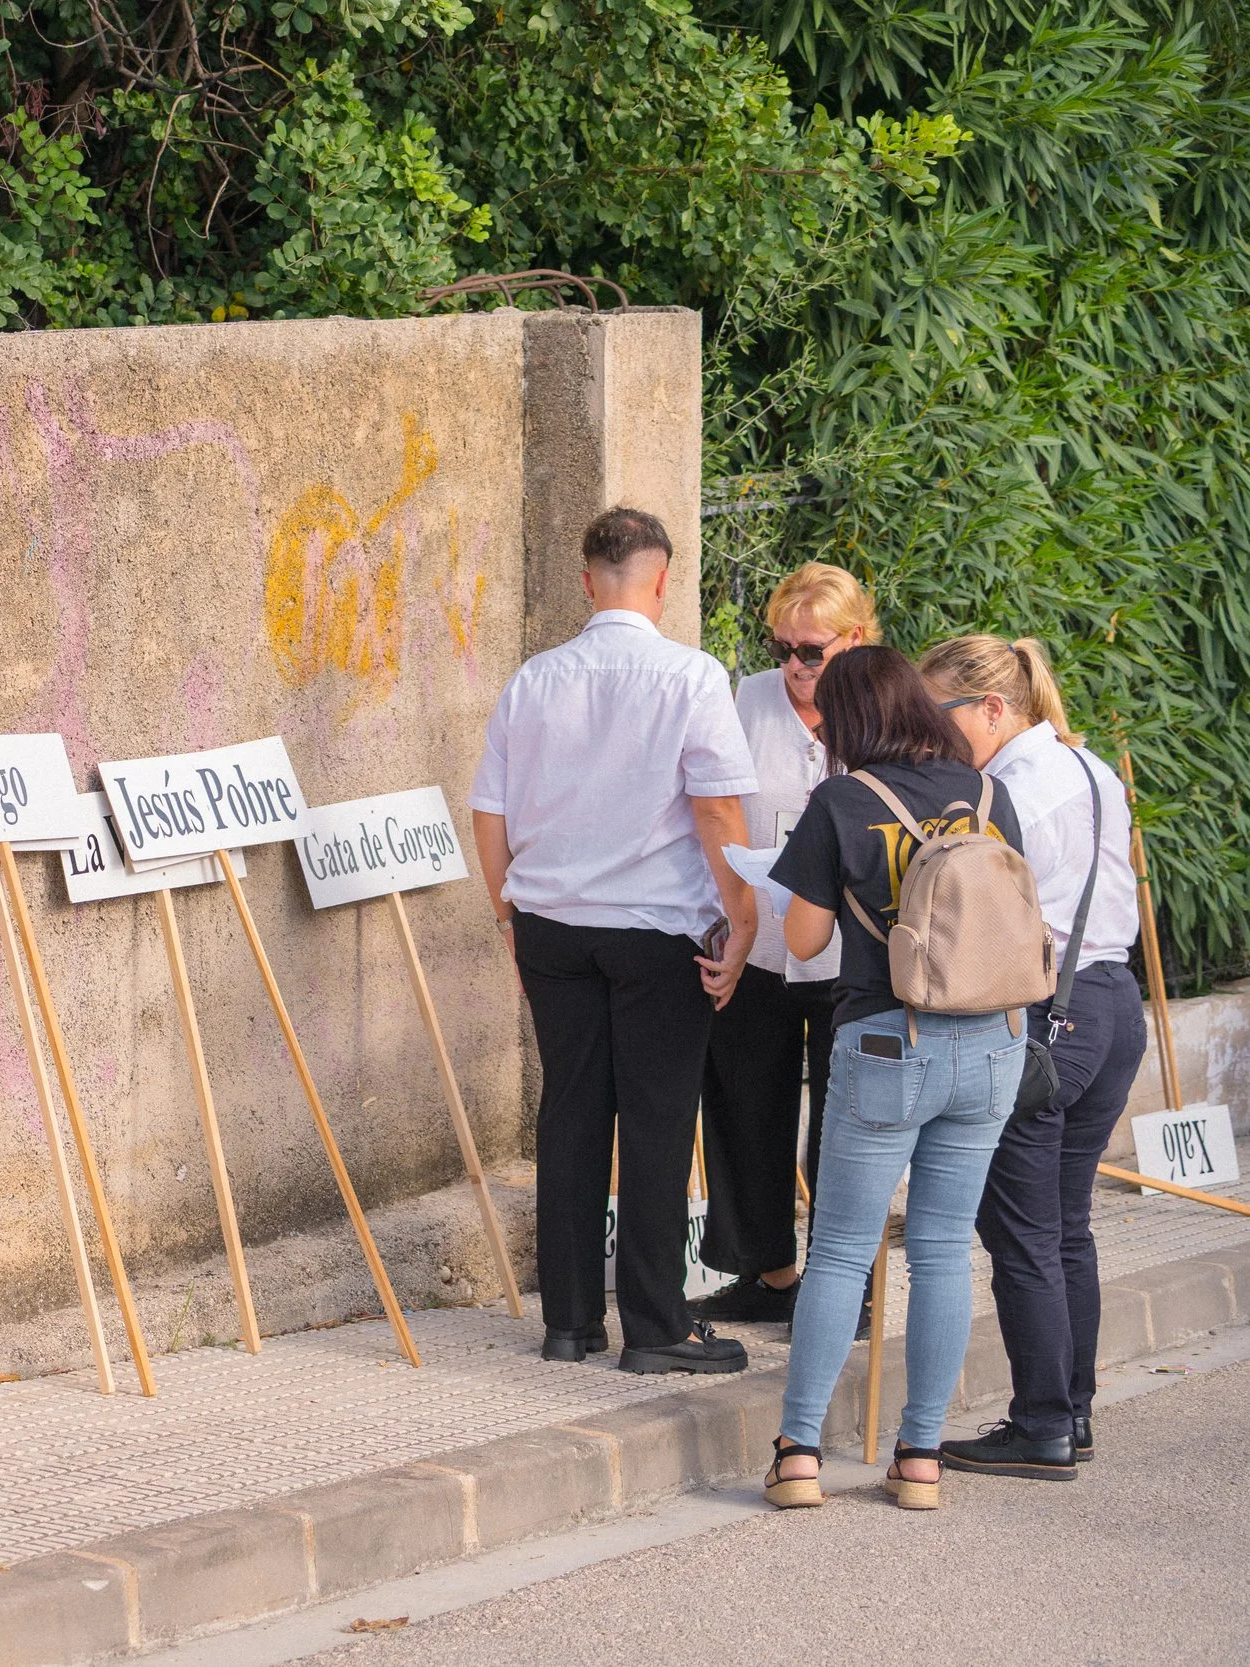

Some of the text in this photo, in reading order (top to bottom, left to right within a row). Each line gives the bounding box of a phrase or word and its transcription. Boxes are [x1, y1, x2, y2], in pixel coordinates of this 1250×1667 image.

[113, 769, 206, 850] Jesús
[196, 764, 297, 830] Pobre
[303, 816, 455, 881] Gata de Gorgos
[1162, 1119, 1215, 1181] Xaló
